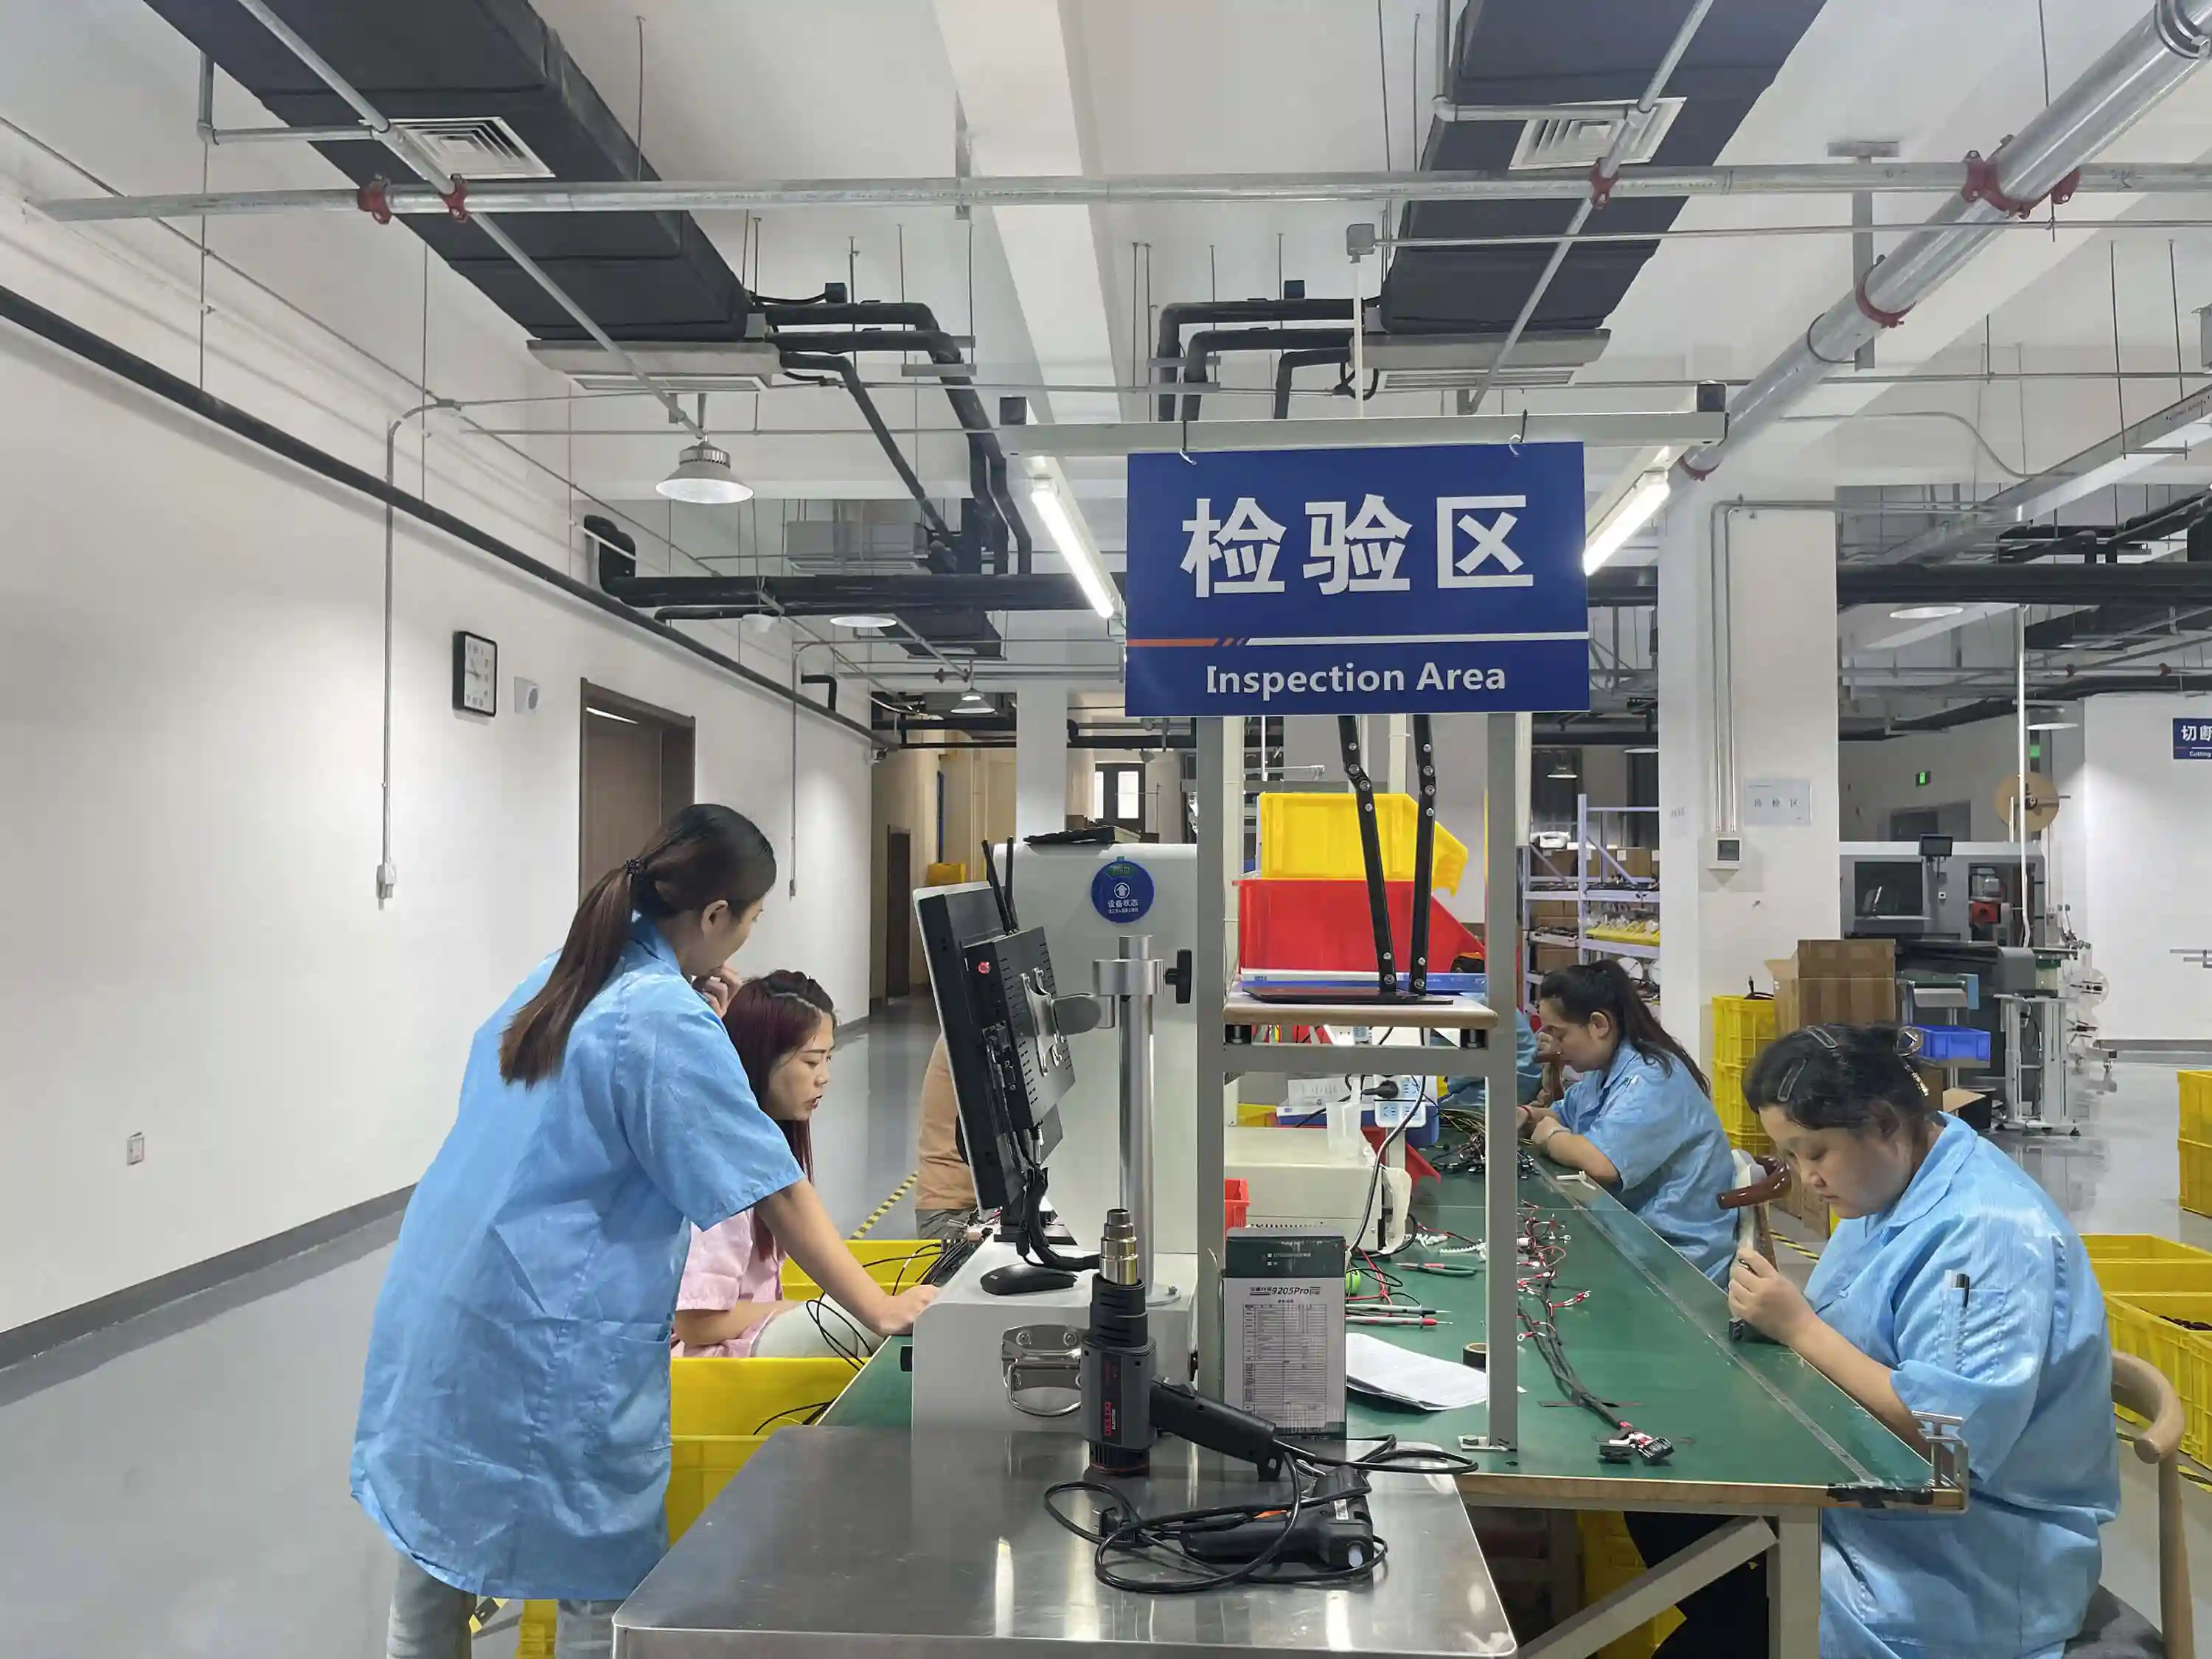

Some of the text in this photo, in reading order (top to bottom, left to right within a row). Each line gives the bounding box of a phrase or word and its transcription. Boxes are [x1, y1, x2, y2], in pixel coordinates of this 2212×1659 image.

[1180, 493, 1534, 598] 检验区
[1206, 662, 1506, 701] Inspection Area
[1107, 898, 1138, 908] 设备状态
